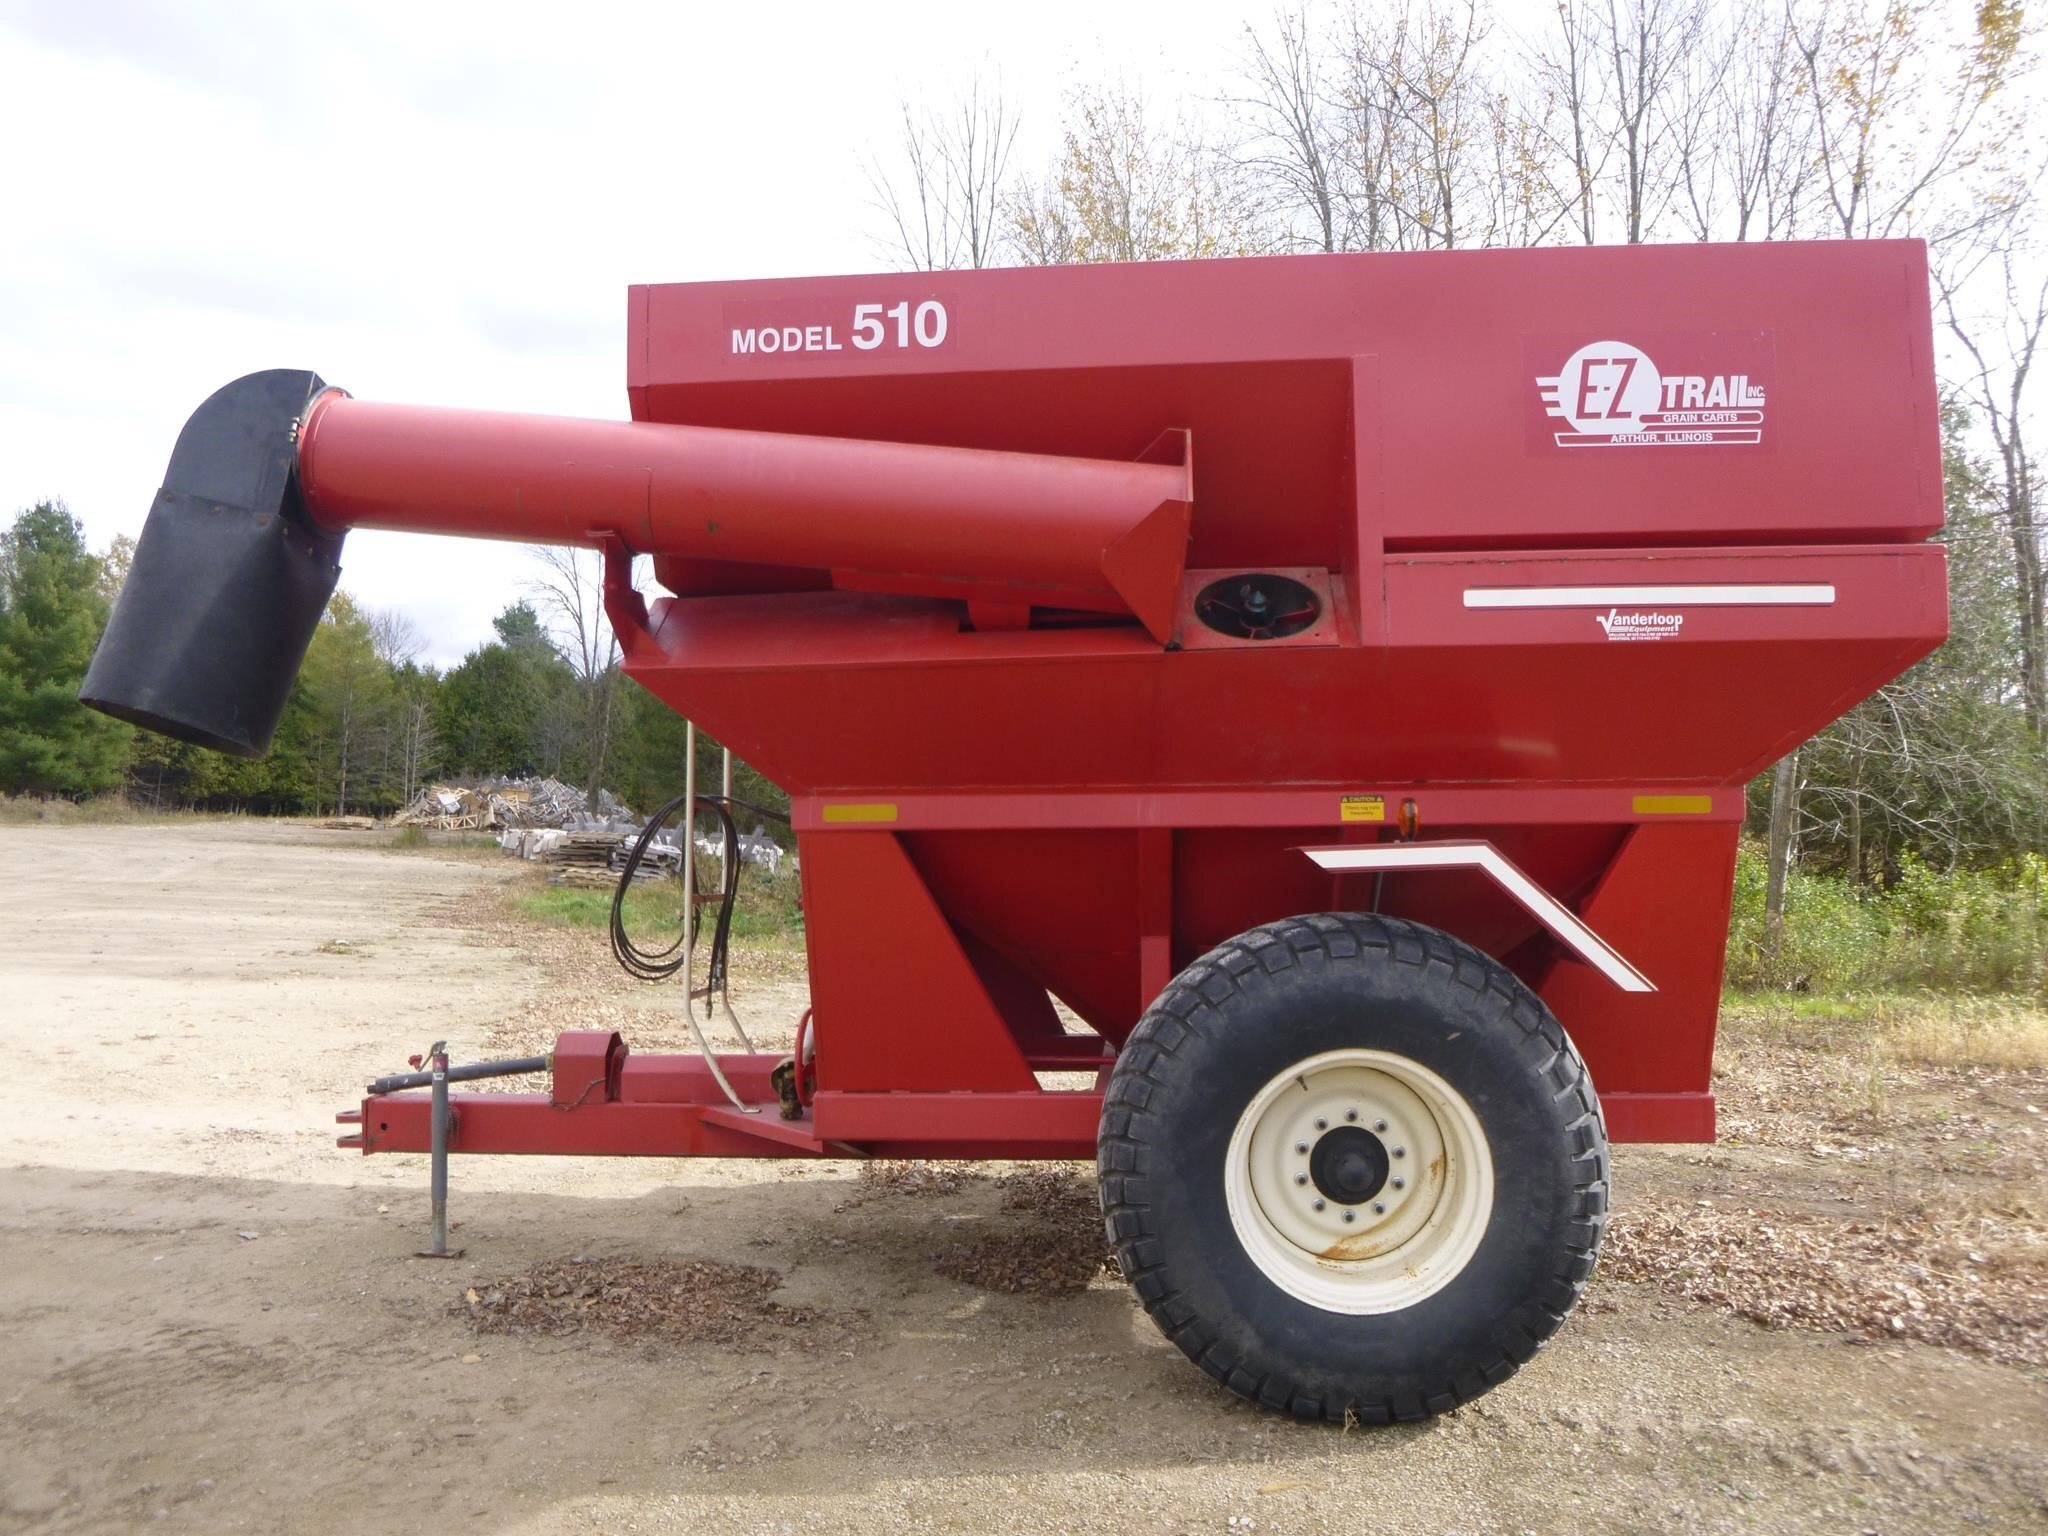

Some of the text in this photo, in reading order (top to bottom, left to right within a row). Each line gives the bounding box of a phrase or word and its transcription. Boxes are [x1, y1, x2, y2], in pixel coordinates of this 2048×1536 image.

[732, 300, 948, 353] MODEL 510
[1575, 358, 1766, 420] E-Z TRAIL INC.
[1663, 413, 1738, 424] GRAIN CARTS
[1665, 432, 1713, 443] ILLINOIS
[1596, 608, 1683, 634] Vanderloop
